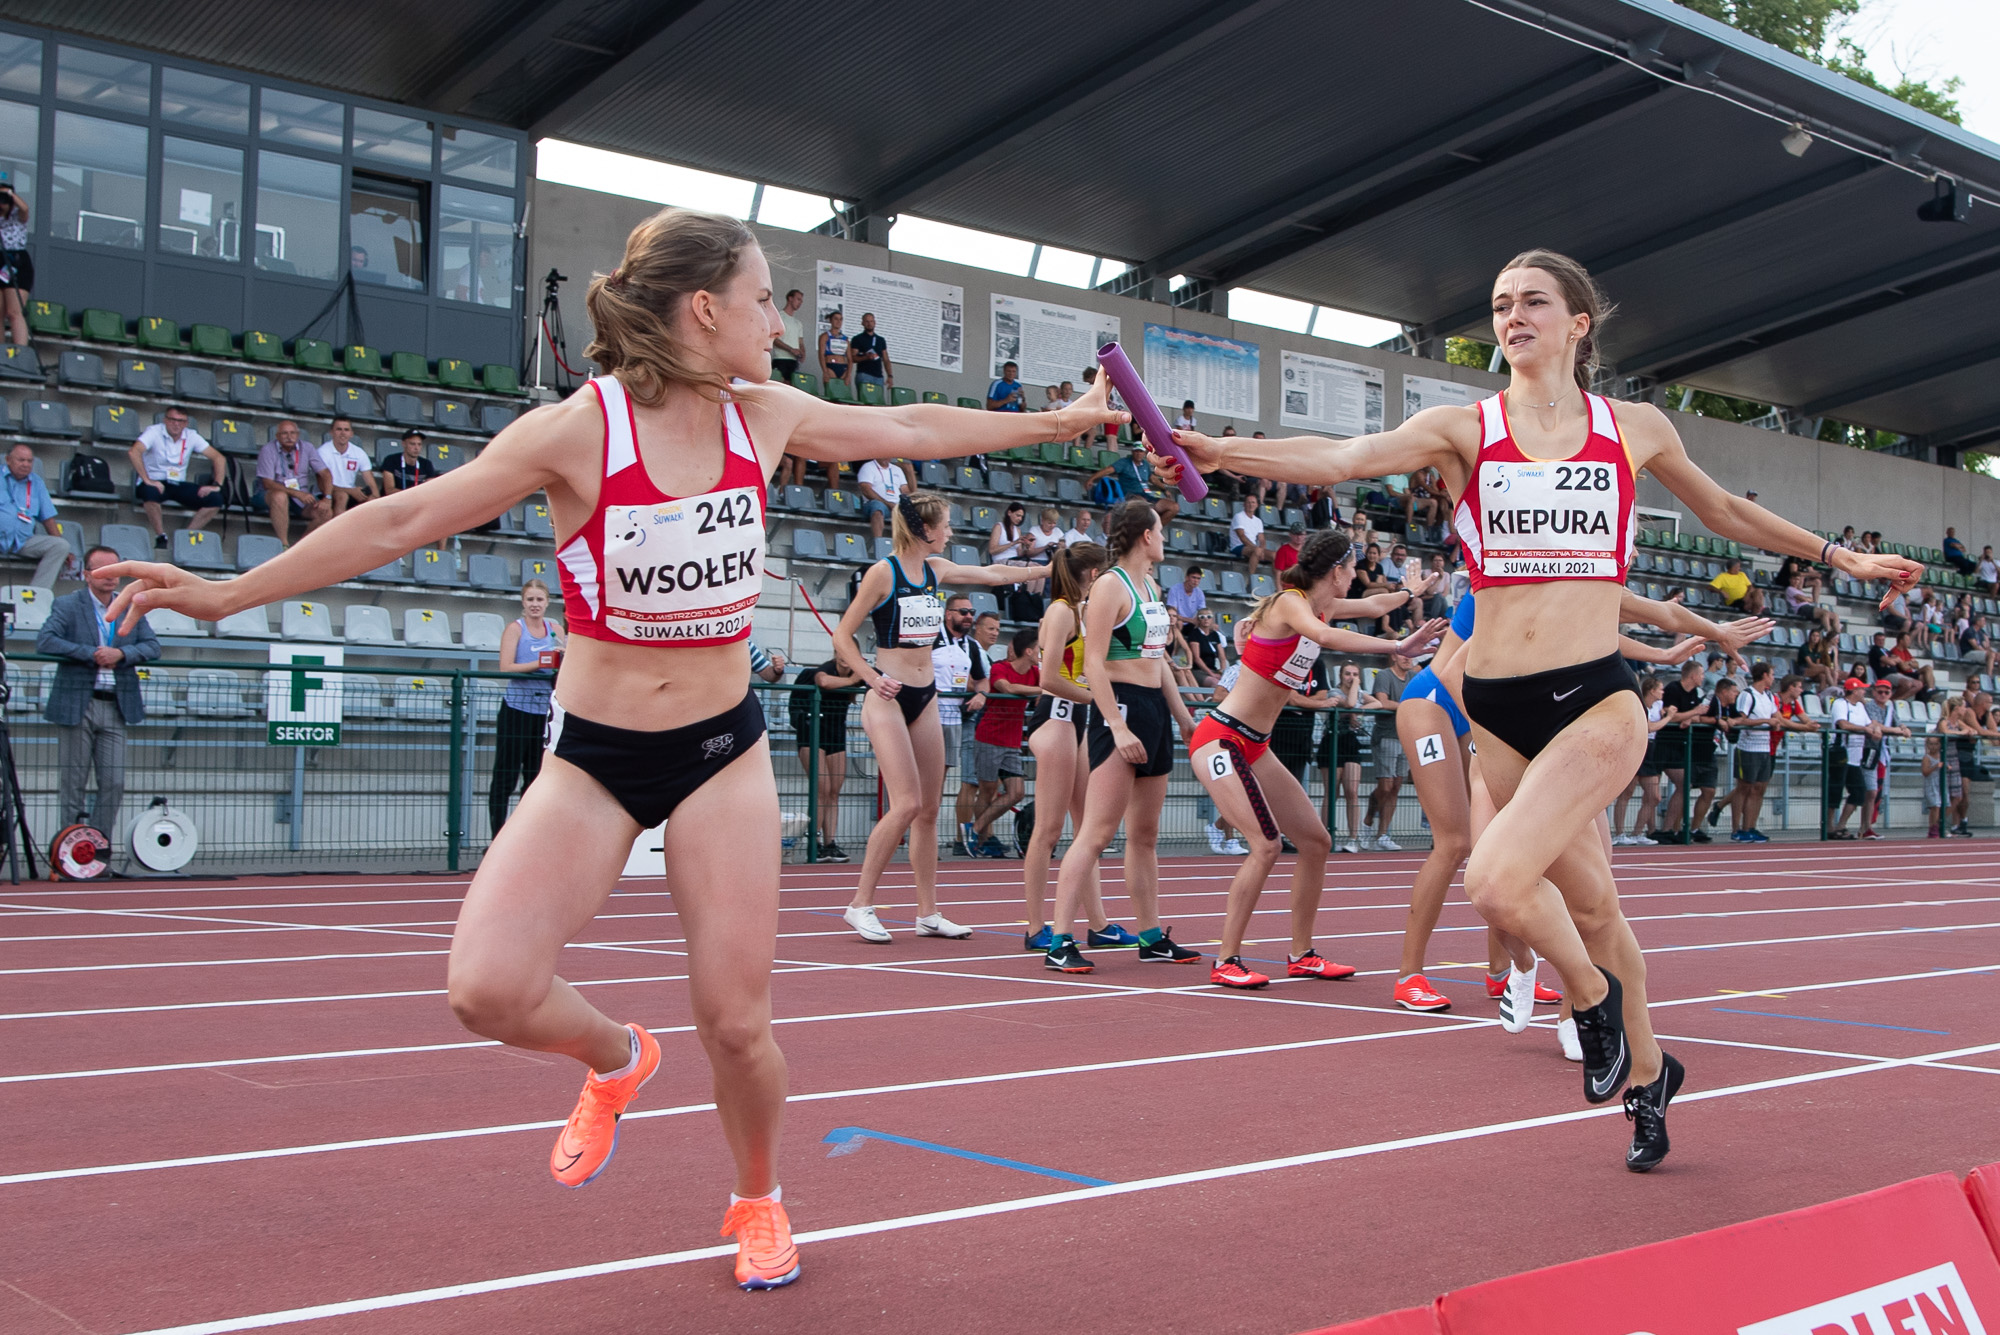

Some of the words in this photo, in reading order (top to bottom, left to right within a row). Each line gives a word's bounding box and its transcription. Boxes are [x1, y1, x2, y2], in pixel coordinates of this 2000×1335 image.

[1555, 466, 1611, 492] 228
[653, 512, 684, 525] SUWAŁKI
[695, 494, 755, 535] 242
[1487, 509, 1610, 535] KIEPURA
[616, 548, 757, 596] WSOŁEK
[1503, 562, 1561, 574] SUWAŁKI
[1565, 562, 1595, 574] 2021
[629, 612, 655, 621] PZLA
[655, 608, 721, 621] MISTRZOSTWA
[722, 601, 746, 613] POLSKI
[634, 623, 710, 638] SUWAŁKI
[715, 615, 745, 635] 2021
[291, 655, 325, 712] F
[1056, 700, 1069, 718] 5
[276, 726, 334, 741] SEKTOR
[1423, 738, 1439, 759] 4
[1213, 755, 1226, 775] 6
